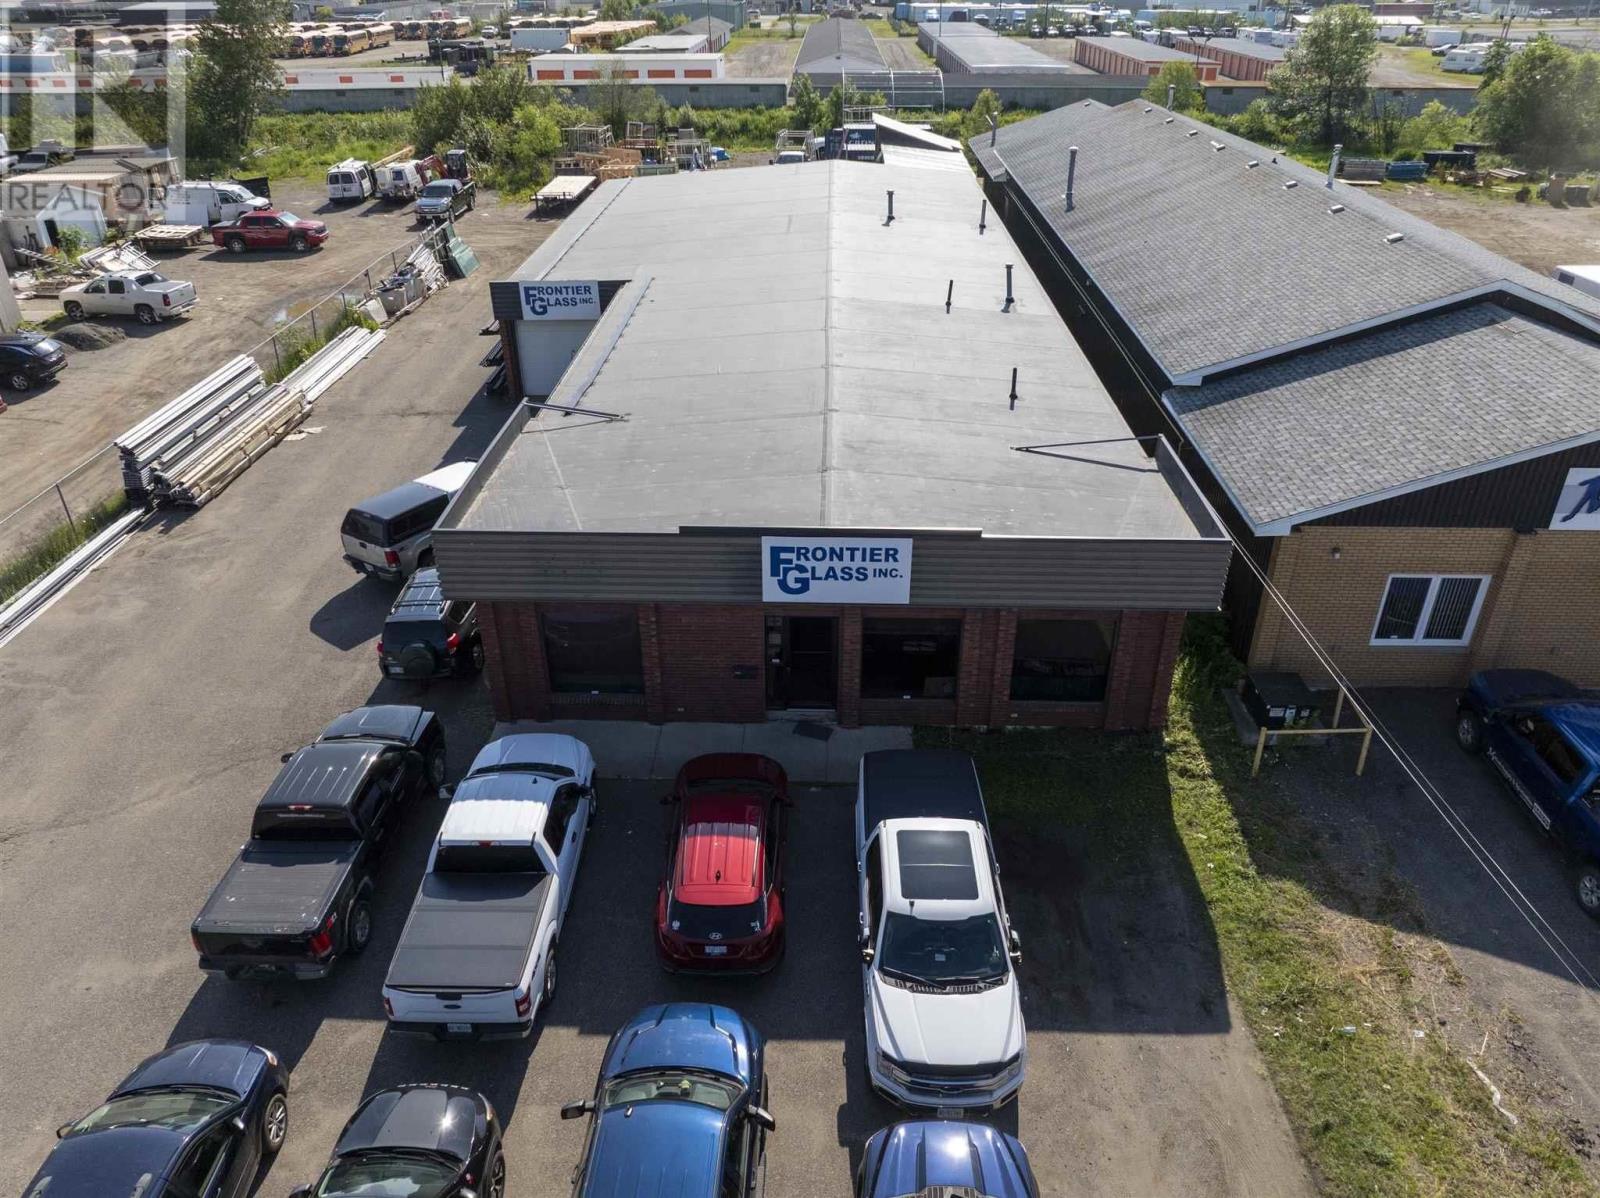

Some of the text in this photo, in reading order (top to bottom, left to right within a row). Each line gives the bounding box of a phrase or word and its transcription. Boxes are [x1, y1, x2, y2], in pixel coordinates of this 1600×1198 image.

[523, 285, 592, 305] FRONTIER
[530, 297, 578, 315] GLASS
[770, 546, 899, 577] FRONTIER
[777, 563, 904, 595] GLASS INC.
